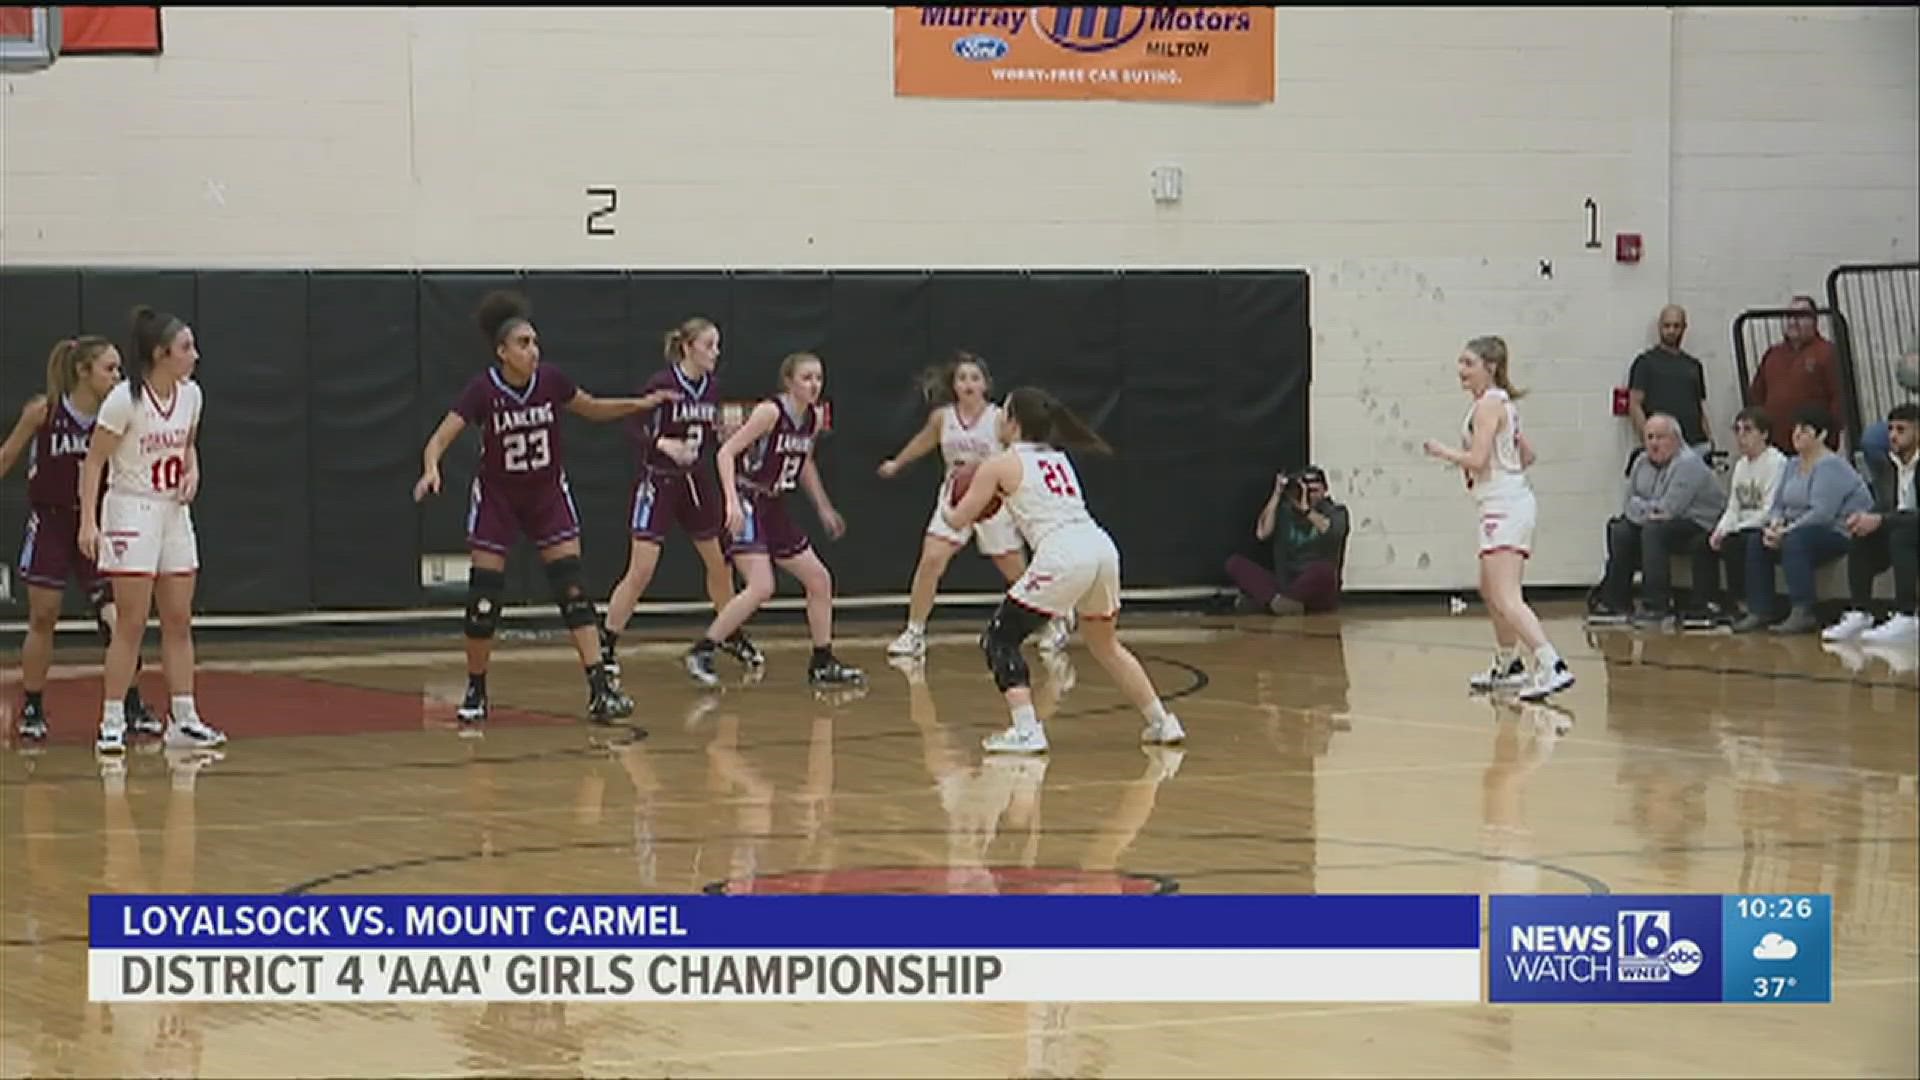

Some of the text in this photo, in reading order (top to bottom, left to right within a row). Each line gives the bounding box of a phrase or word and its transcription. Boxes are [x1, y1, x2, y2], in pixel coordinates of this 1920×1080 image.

[920, 6, 1026, 34] Murray
[1150, 6, 1250, 31] Motors
[1146, 42, 1209, 58] MILTON
[1089, 69, 1119, 84] CAR
[586, 189, 617, 235] 2
[1583, 196, 1603, 248] 1
[493, 403, 555, 435] LANCERS
[503, 430, 551, 471] 23
[151, 455, 184, 492] 10
[1037, 459, 1077, 497] 21
